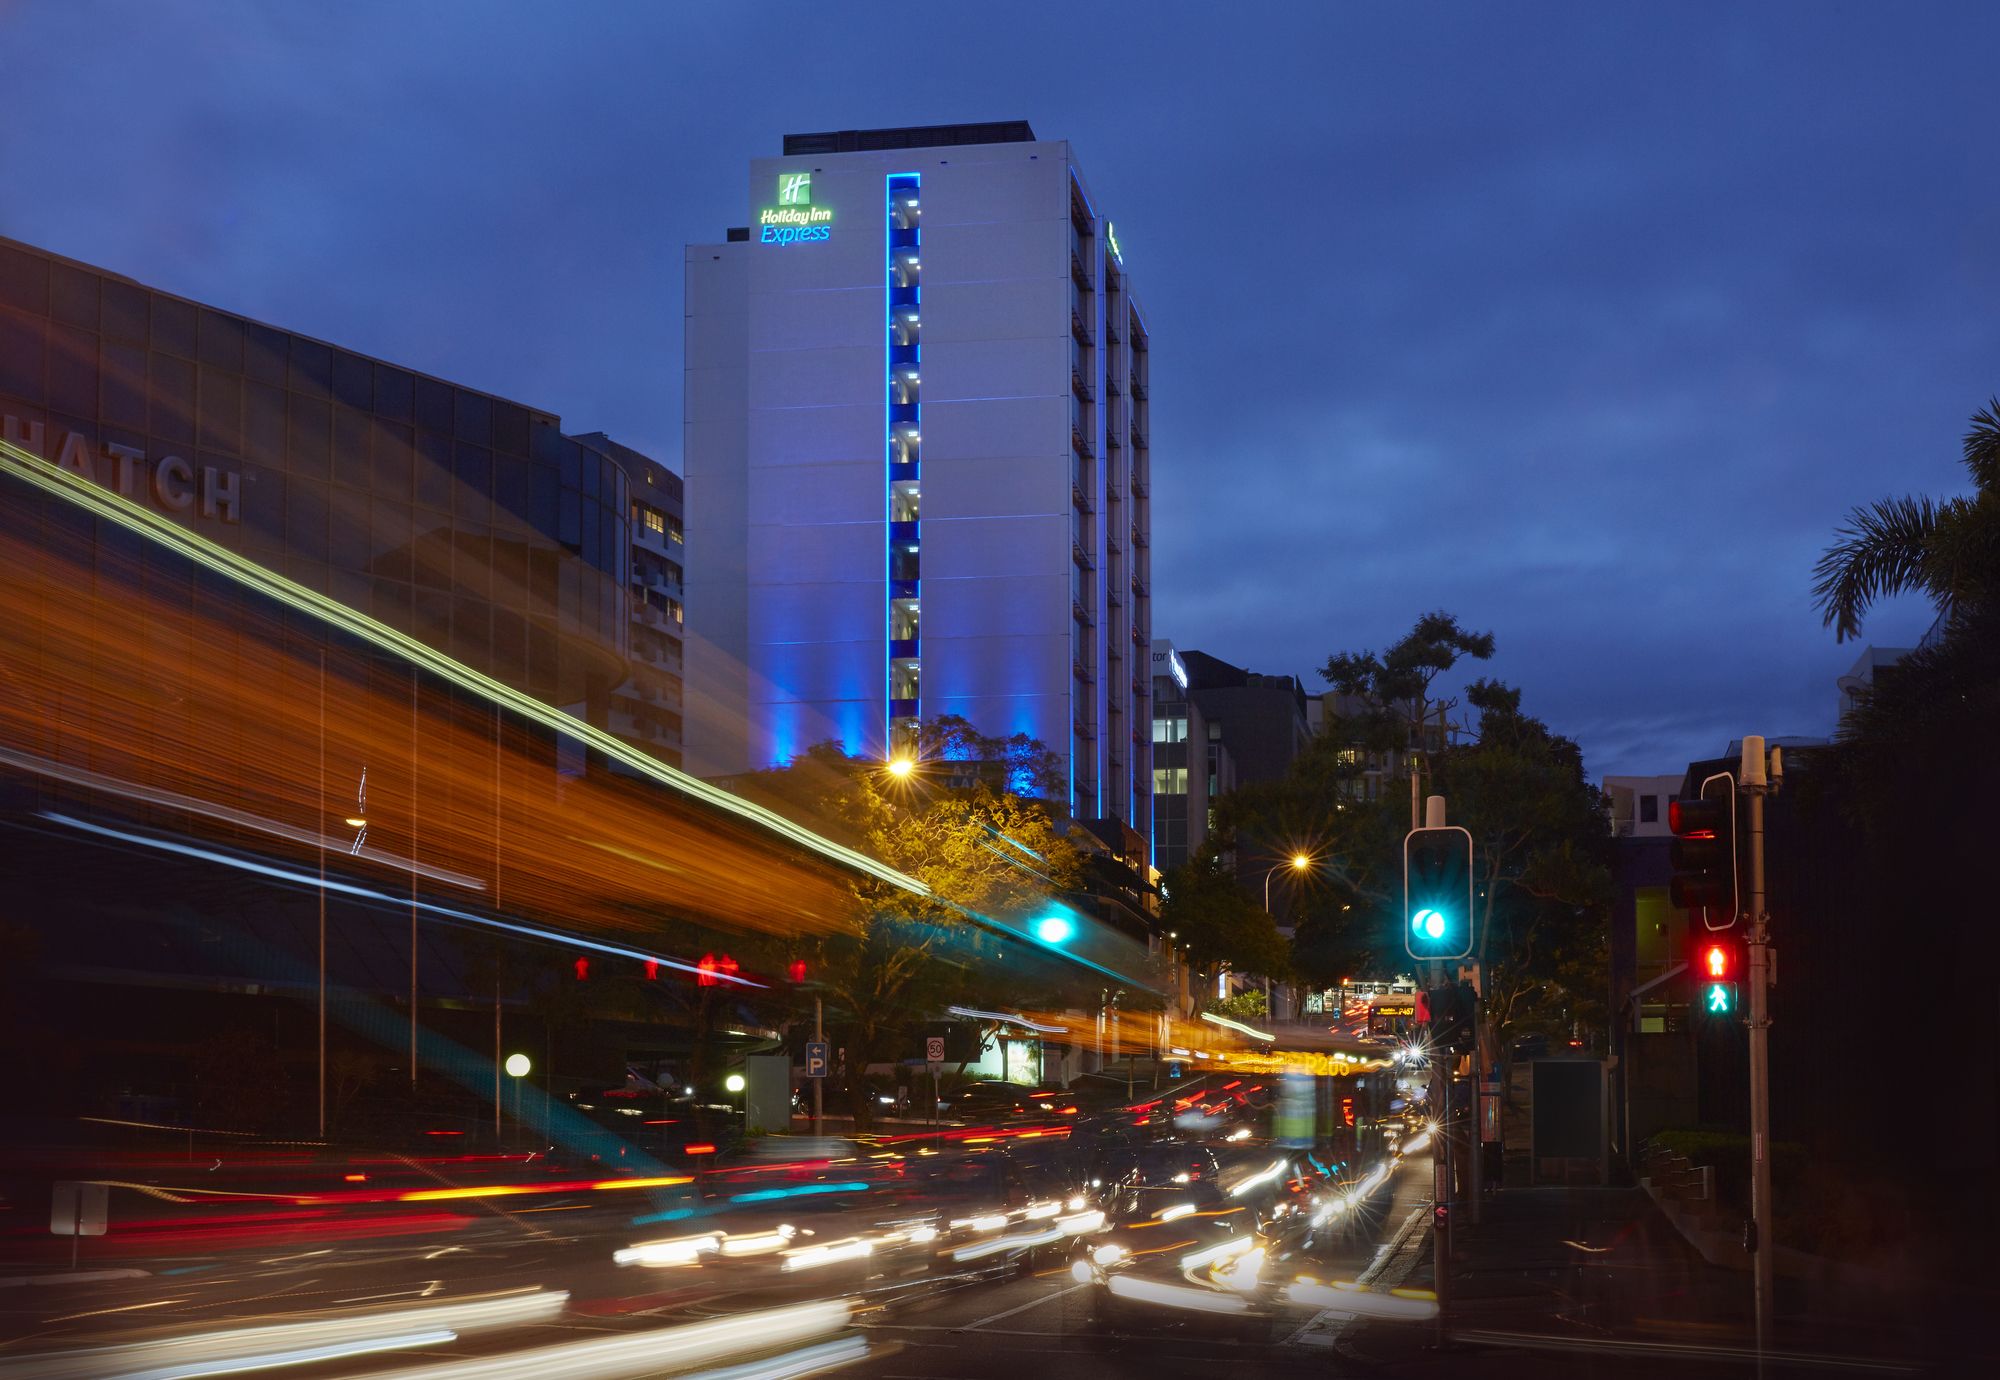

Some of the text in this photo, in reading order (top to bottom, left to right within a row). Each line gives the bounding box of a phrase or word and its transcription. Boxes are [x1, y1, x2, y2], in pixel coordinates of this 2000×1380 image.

[761, 207, 832, 225] Holiday Inn
[761, 225, 831, 246] Express
[3, 414, 242, 525] HATCH
[930, 1044, 941, 1054] 50
[809, 1057, 824, 1074] P
